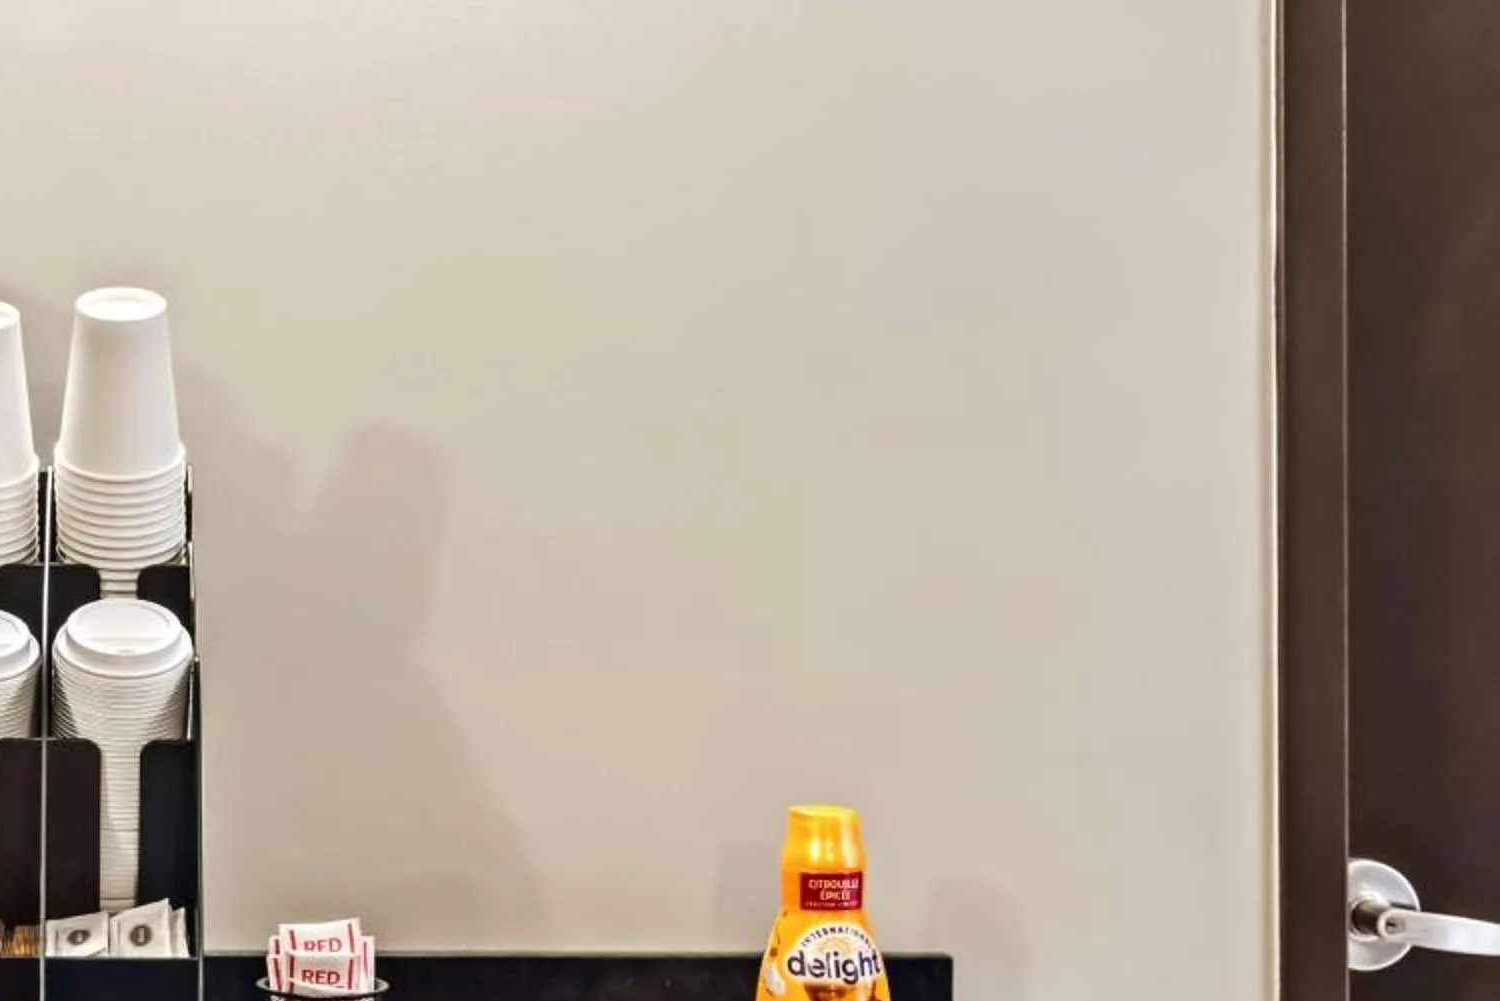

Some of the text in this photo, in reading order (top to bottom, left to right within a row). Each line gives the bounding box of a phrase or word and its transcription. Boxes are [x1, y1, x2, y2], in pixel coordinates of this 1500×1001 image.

[303, 937, 342, 952] RED
[787, 950, 881, 985] delight
[301, 969, 341, 986] RED
